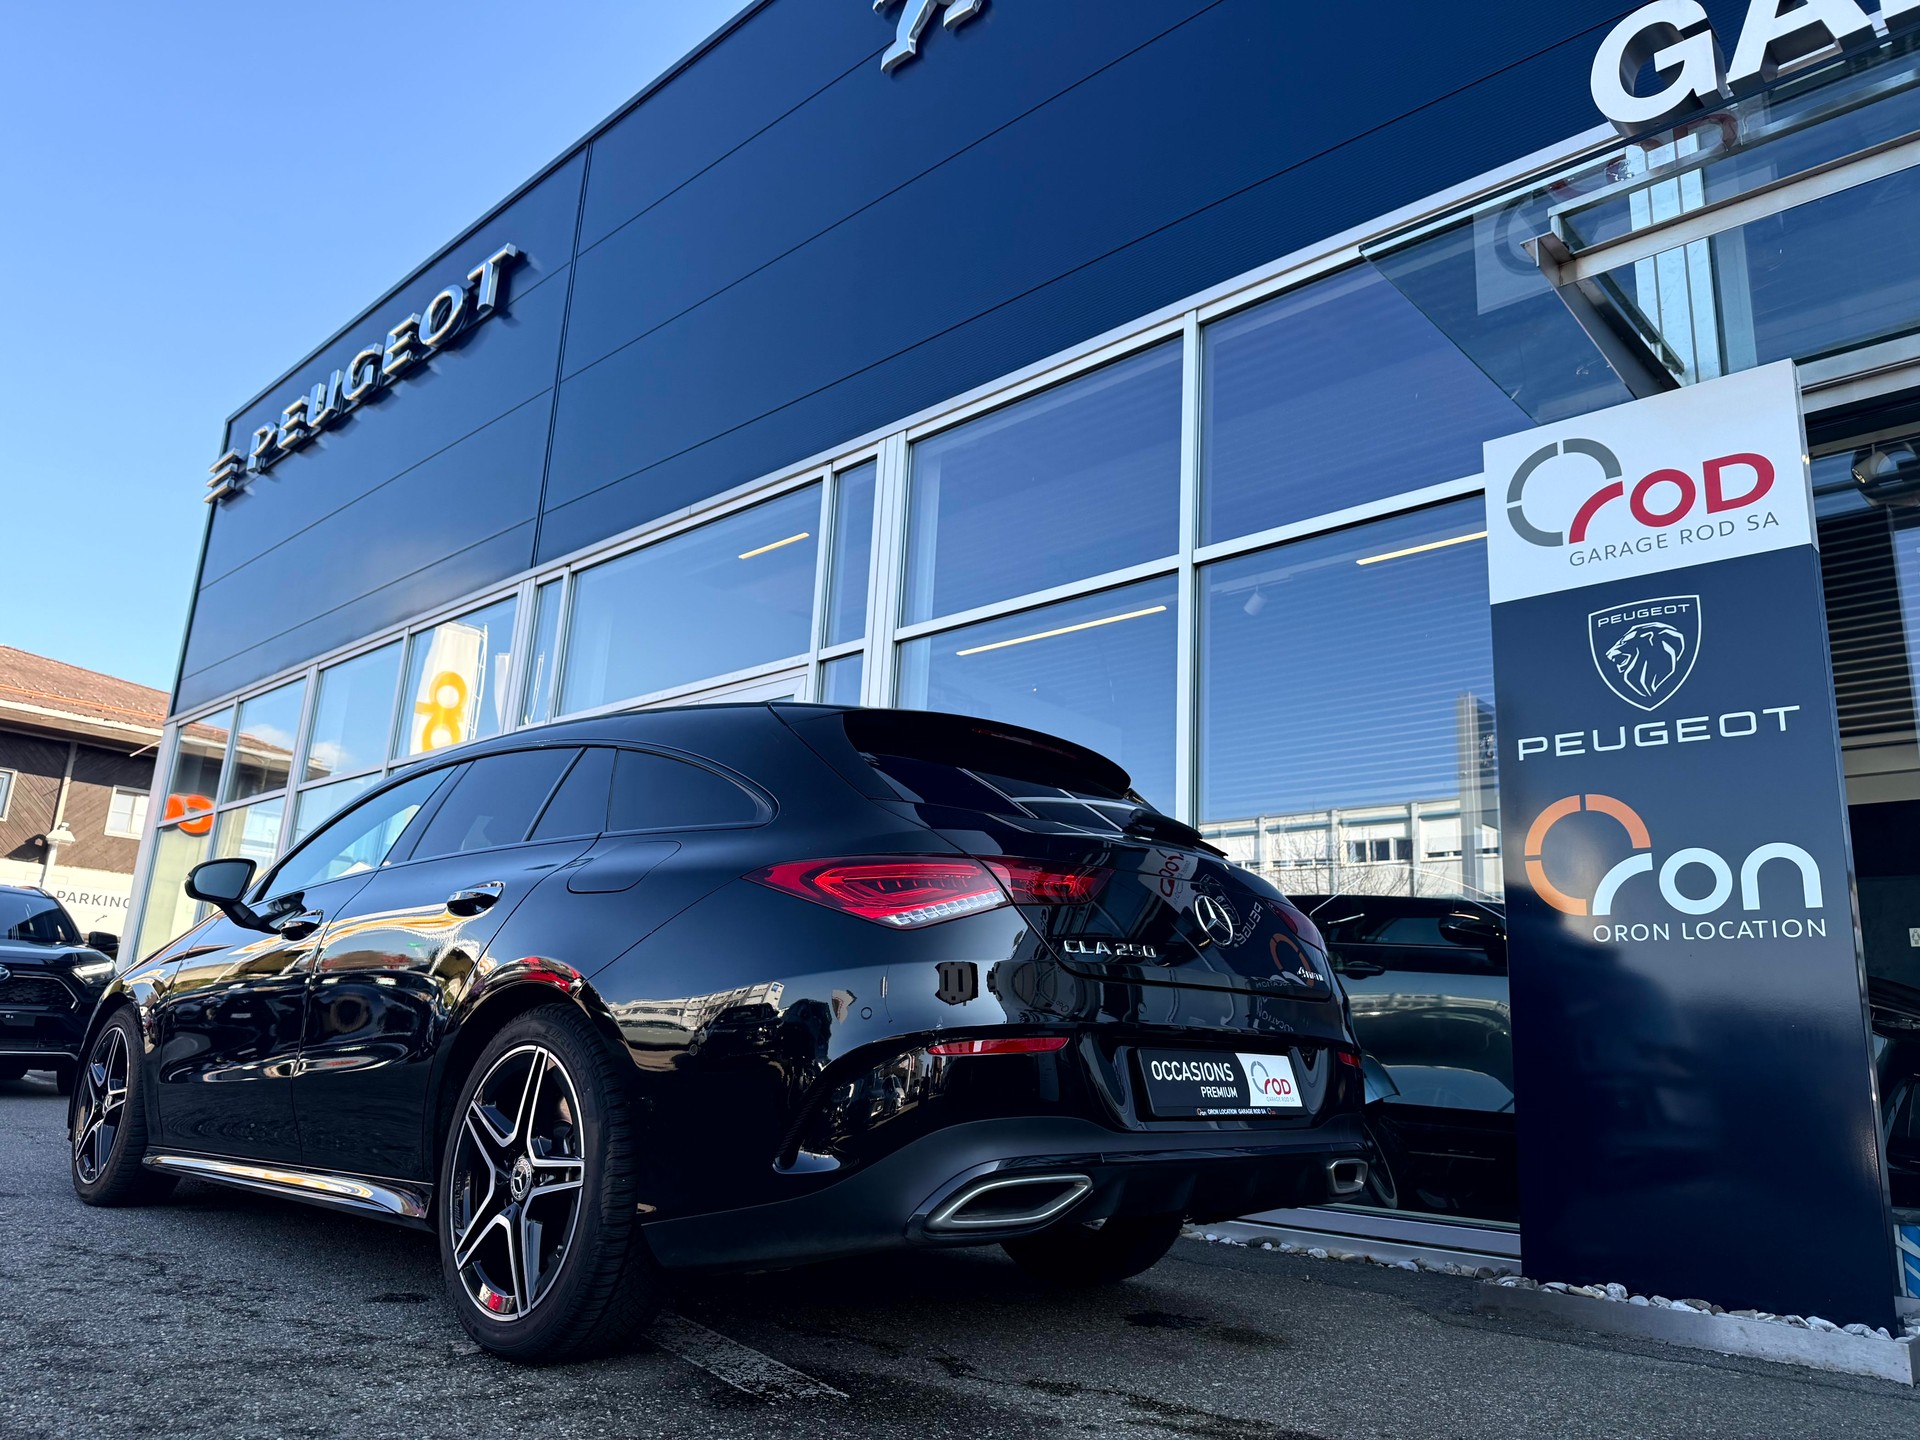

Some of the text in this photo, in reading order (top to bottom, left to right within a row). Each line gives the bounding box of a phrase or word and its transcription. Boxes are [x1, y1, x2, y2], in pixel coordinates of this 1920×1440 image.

[1591, 0, 1920, 122] GA
[247, 242, 520, 474] PEUGEOT
[1569, 511, 1780, 567] GARAGE ROD SA
[1597, 603, 1690, 628] PEUGEOT
[1517, 705, 1801, 761] PEUGEOT
[1592, 918, 1827, 942] ORON LOCATION
[1063, 940, 1157, 958] CLA 250
[1151, 1060, 1234, 1082] OCCASIONS
[1200, 1086, 1238, 1098] PREMIUM
